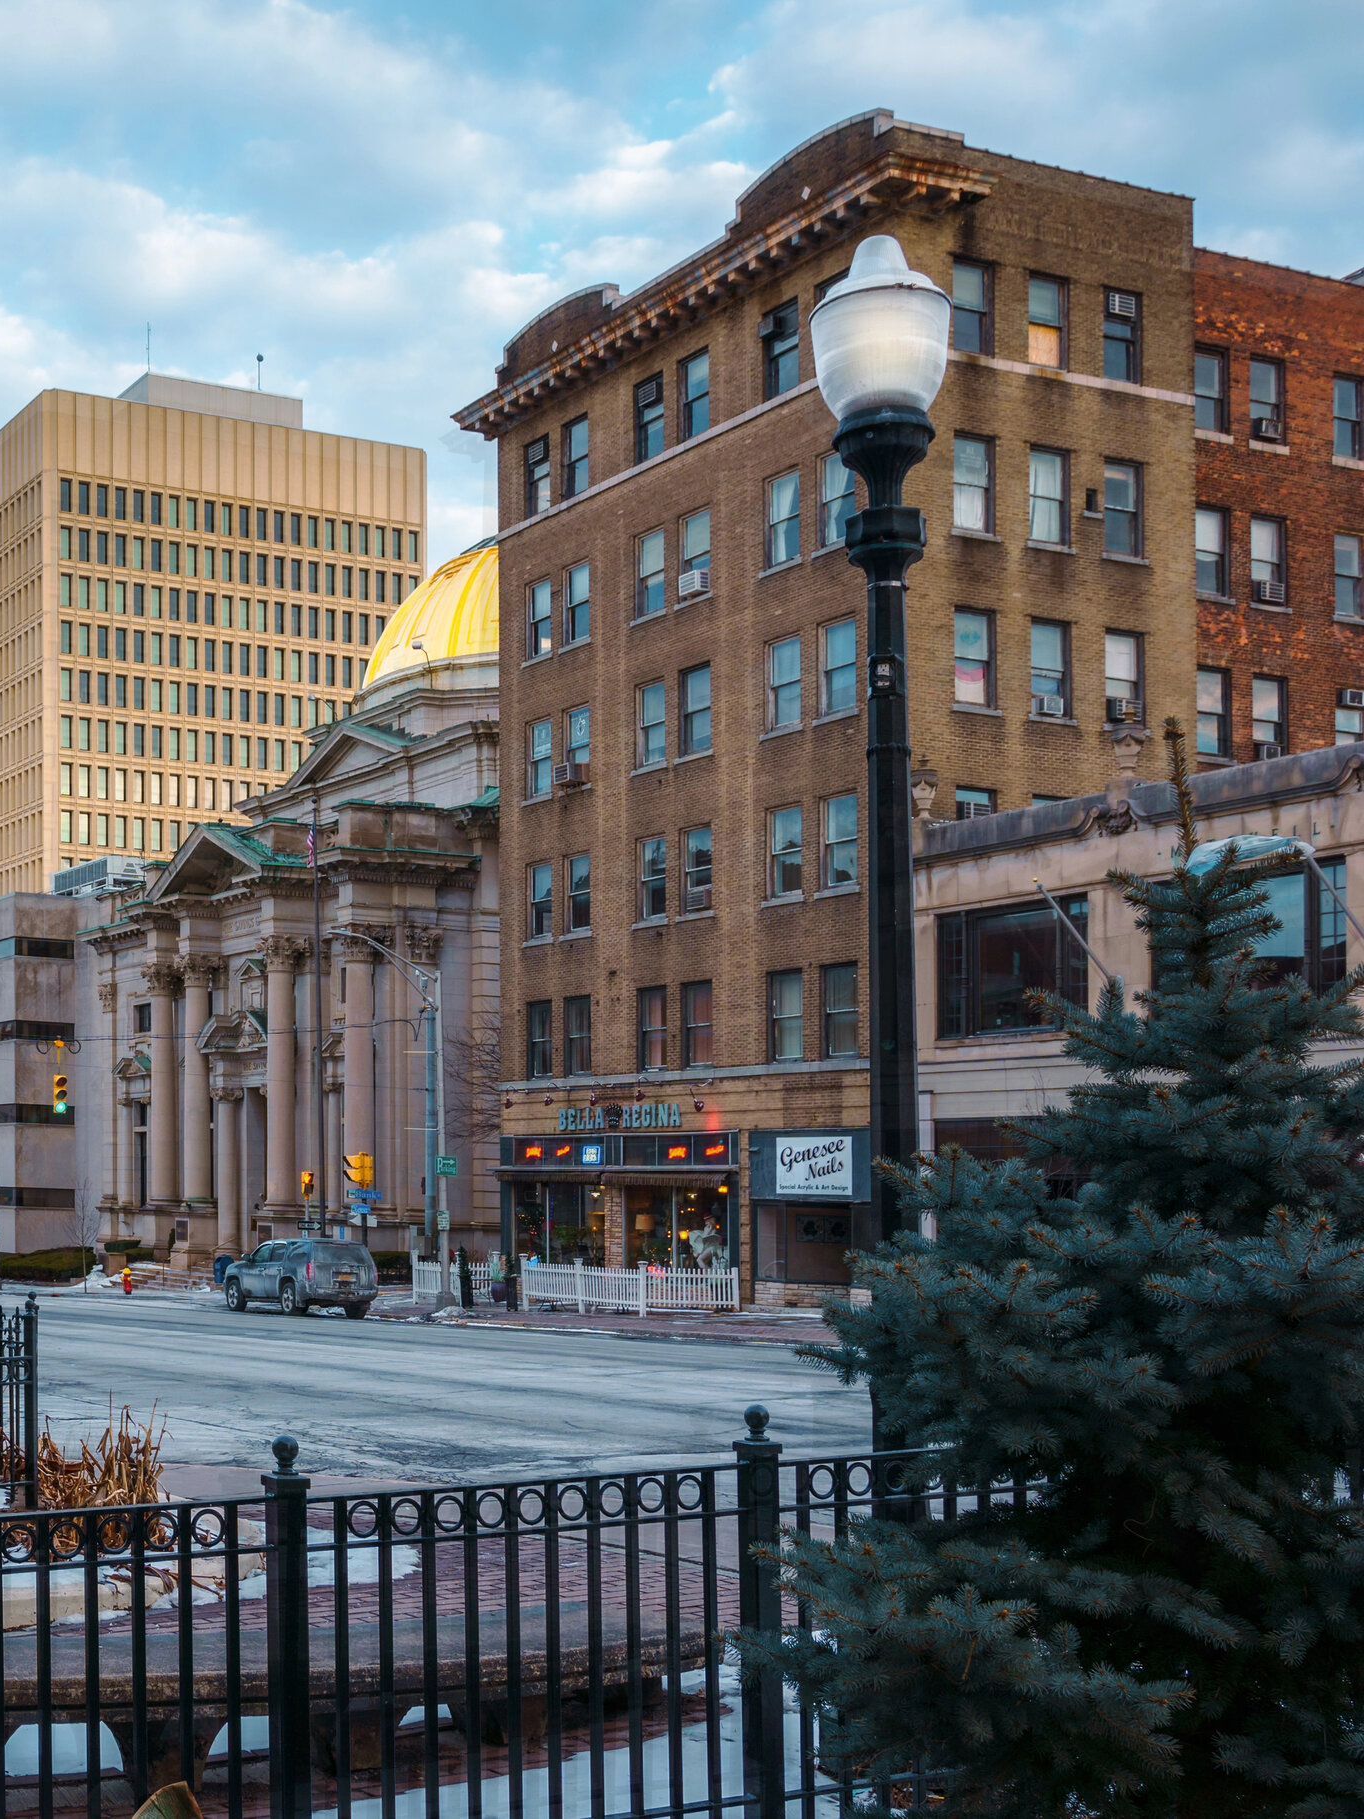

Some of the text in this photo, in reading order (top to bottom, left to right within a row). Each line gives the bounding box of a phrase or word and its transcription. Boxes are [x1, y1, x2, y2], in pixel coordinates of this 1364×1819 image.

[558, 1103, 681, 1130] BELLA REGINA
[780, 1139, 845, 1172] Genesee
[805, 1156, 844, 1181] Nails
[356, 1190, 375, 1199] Bank
